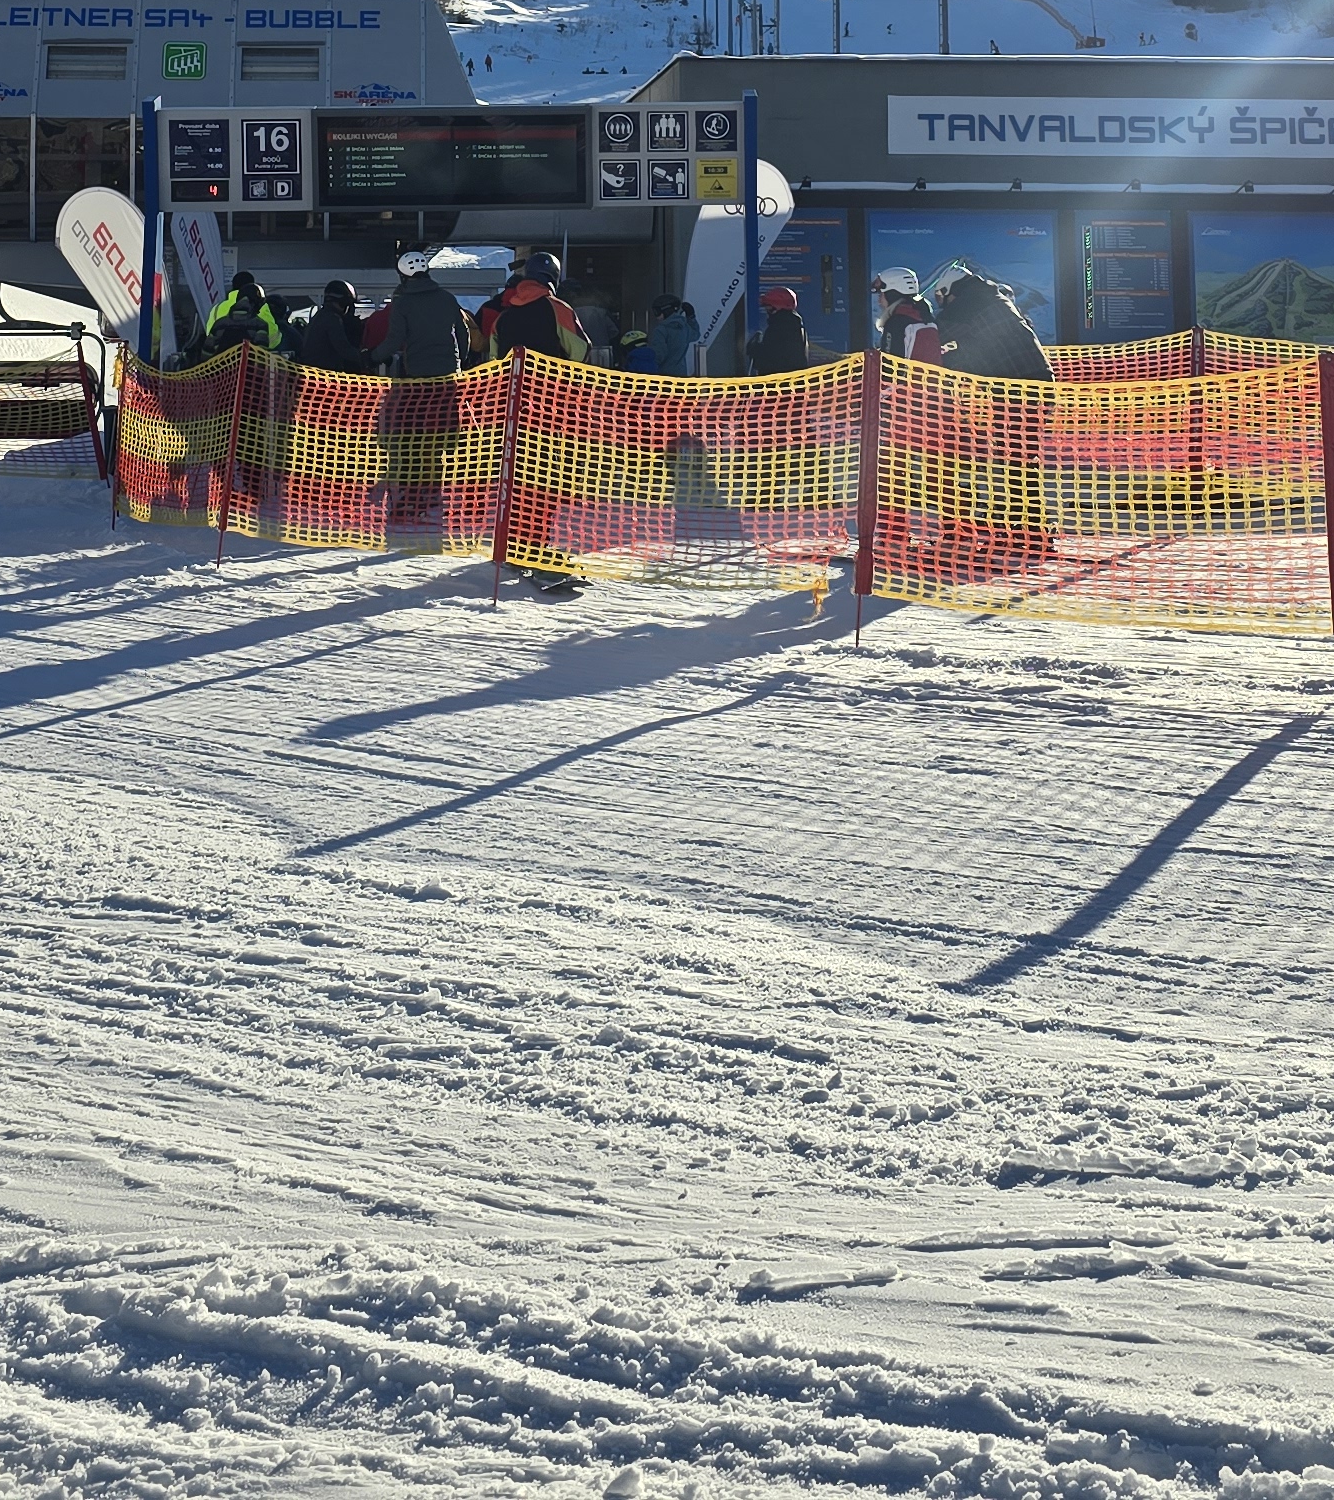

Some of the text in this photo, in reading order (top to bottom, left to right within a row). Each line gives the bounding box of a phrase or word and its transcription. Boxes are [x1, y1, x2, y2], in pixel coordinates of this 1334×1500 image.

[144, 8, 213, 27] SA4
[245, 9, 380, 28] BUBBLE
[917, 106, 1215, 144] TANVALDSKÝ
[253, 126, 290, 152] 16
[277, 181, 289, 196] D
[720, 278, 740, 307] Auto
